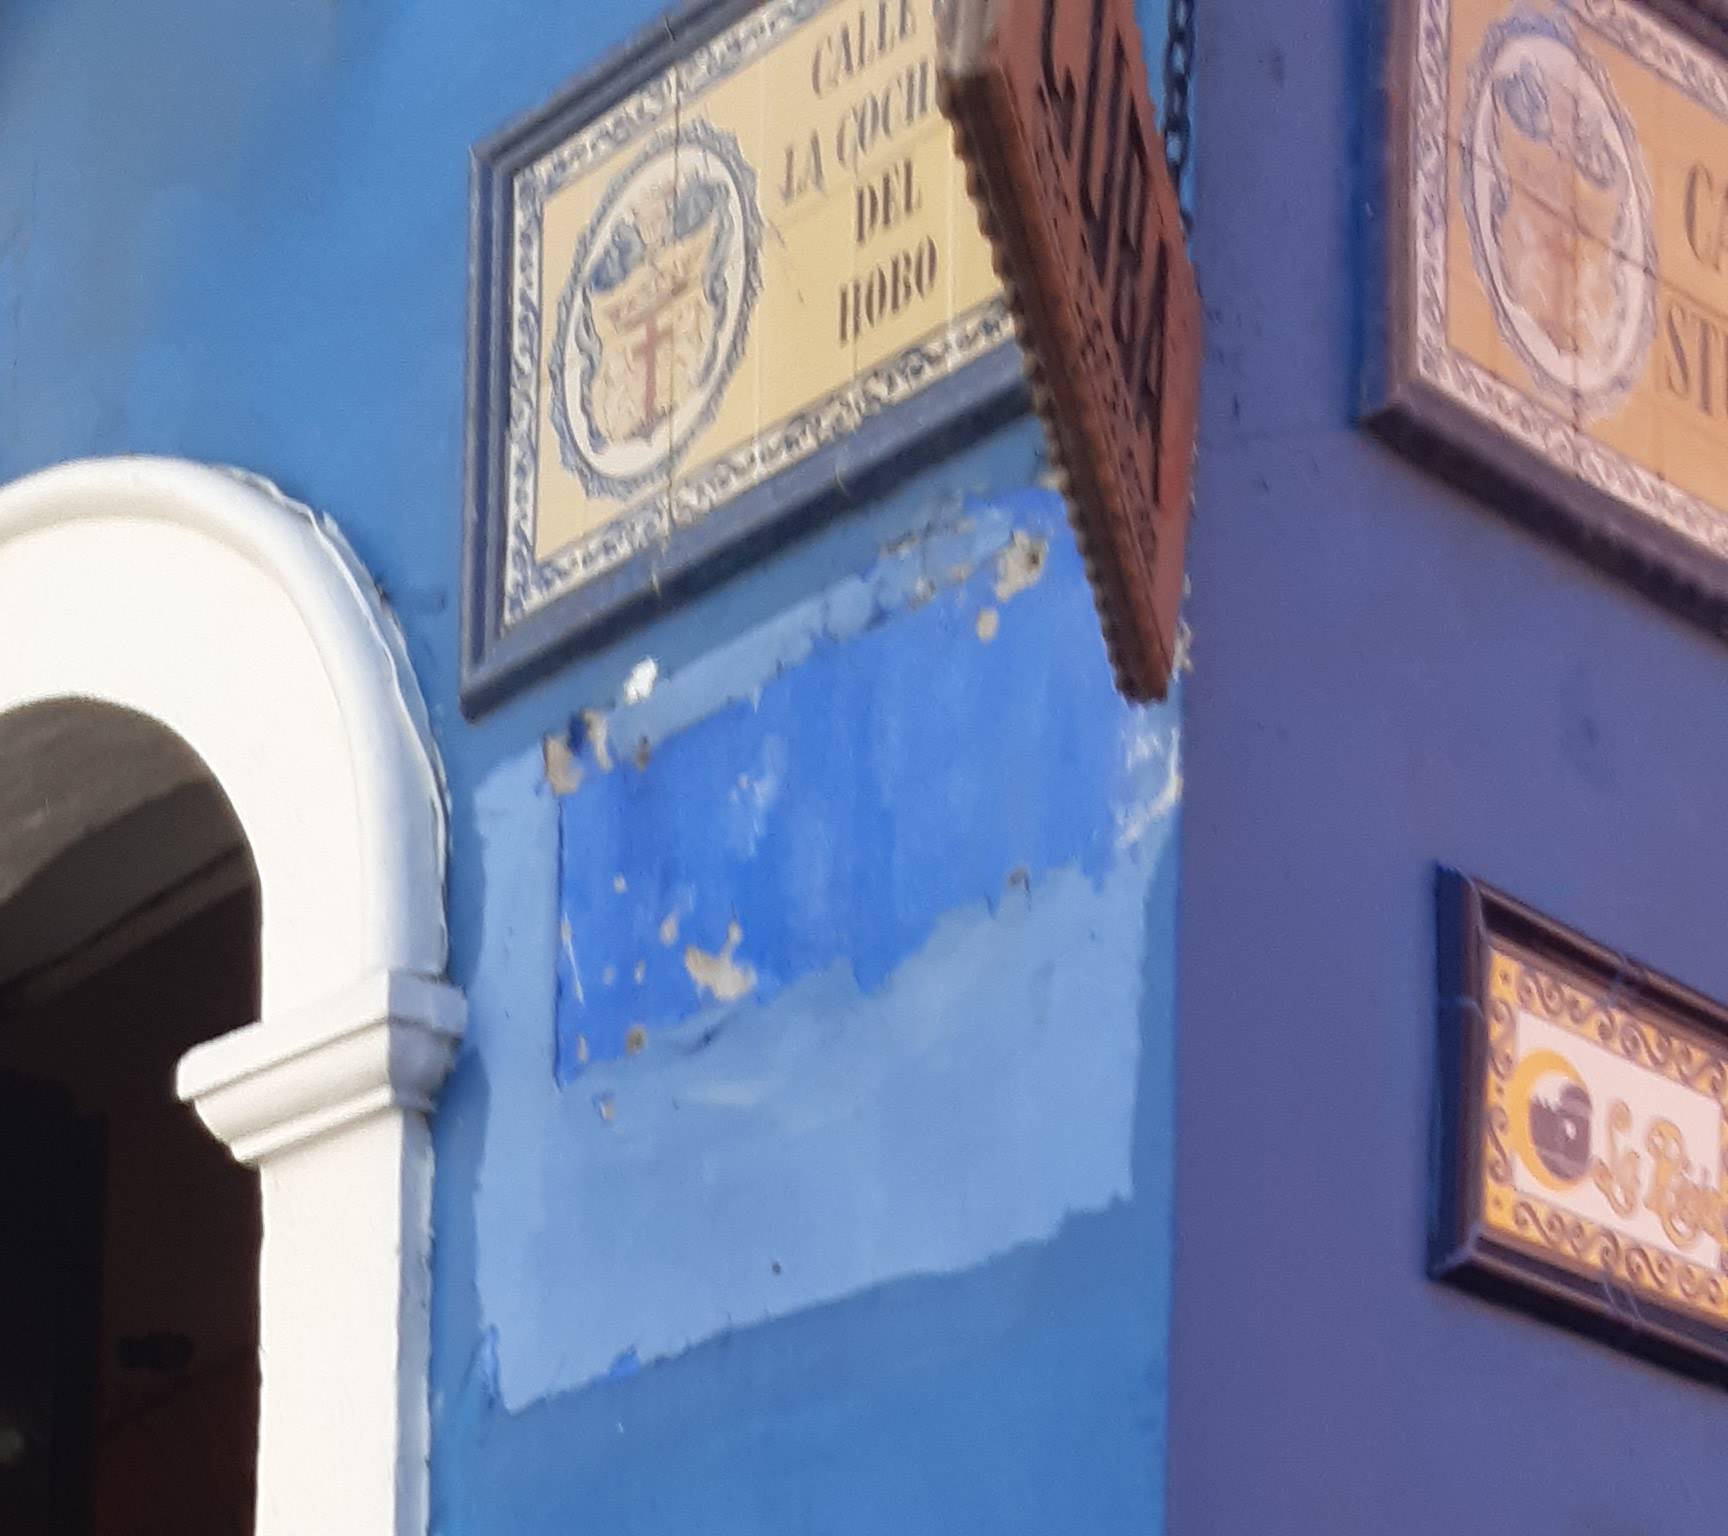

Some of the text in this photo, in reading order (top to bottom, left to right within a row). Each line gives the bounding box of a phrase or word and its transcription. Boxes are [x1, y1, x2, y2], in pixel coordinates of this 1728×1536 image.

[811, 0, 918, 96] CALLE
[782, 60, 934, 204] LA COCH
[854, 157, 922, 245] DEL
[838, 234, 937, 343] HOBO
